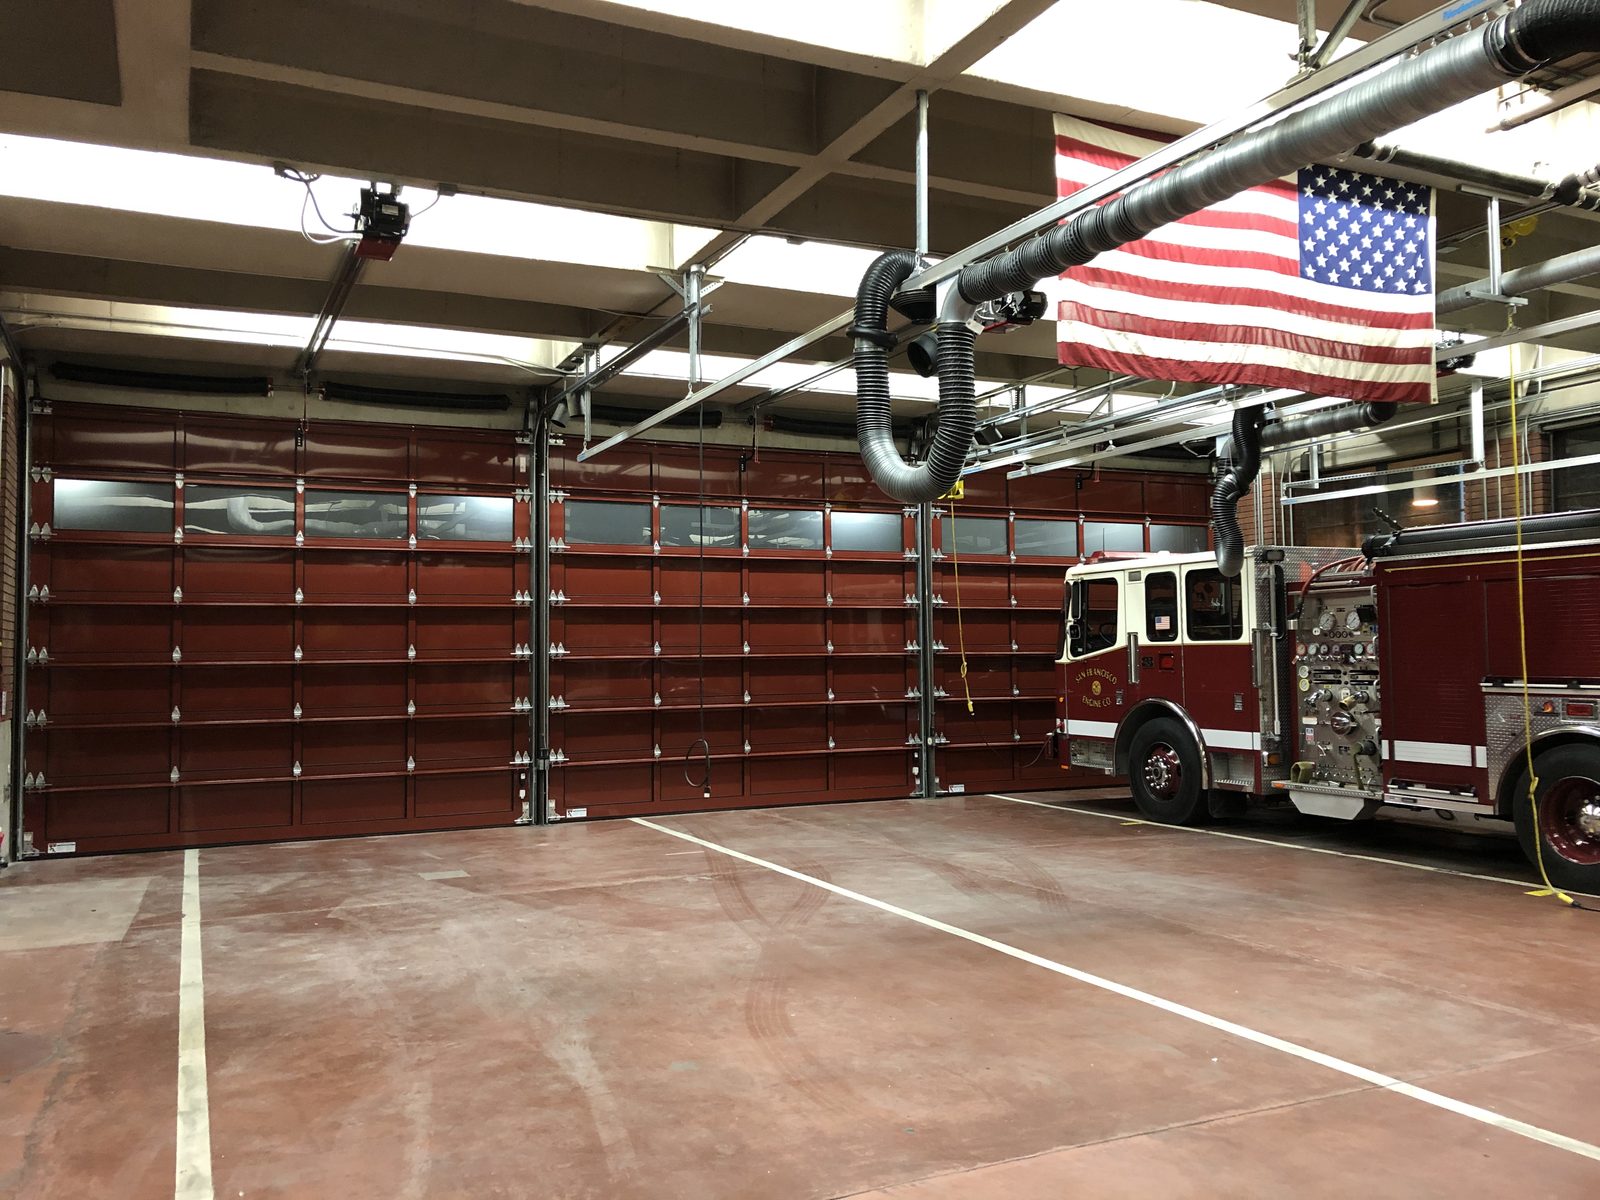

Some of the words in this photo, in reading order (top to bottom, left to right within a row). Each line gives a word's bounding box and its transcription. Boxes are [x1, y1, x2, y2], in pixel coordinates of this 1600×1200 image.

[1075, 671, 1086, 683] SAN
[1086, 668, 1118, 684] FRANCISCO
[1082, 696, 1101, 707] ENGINE
